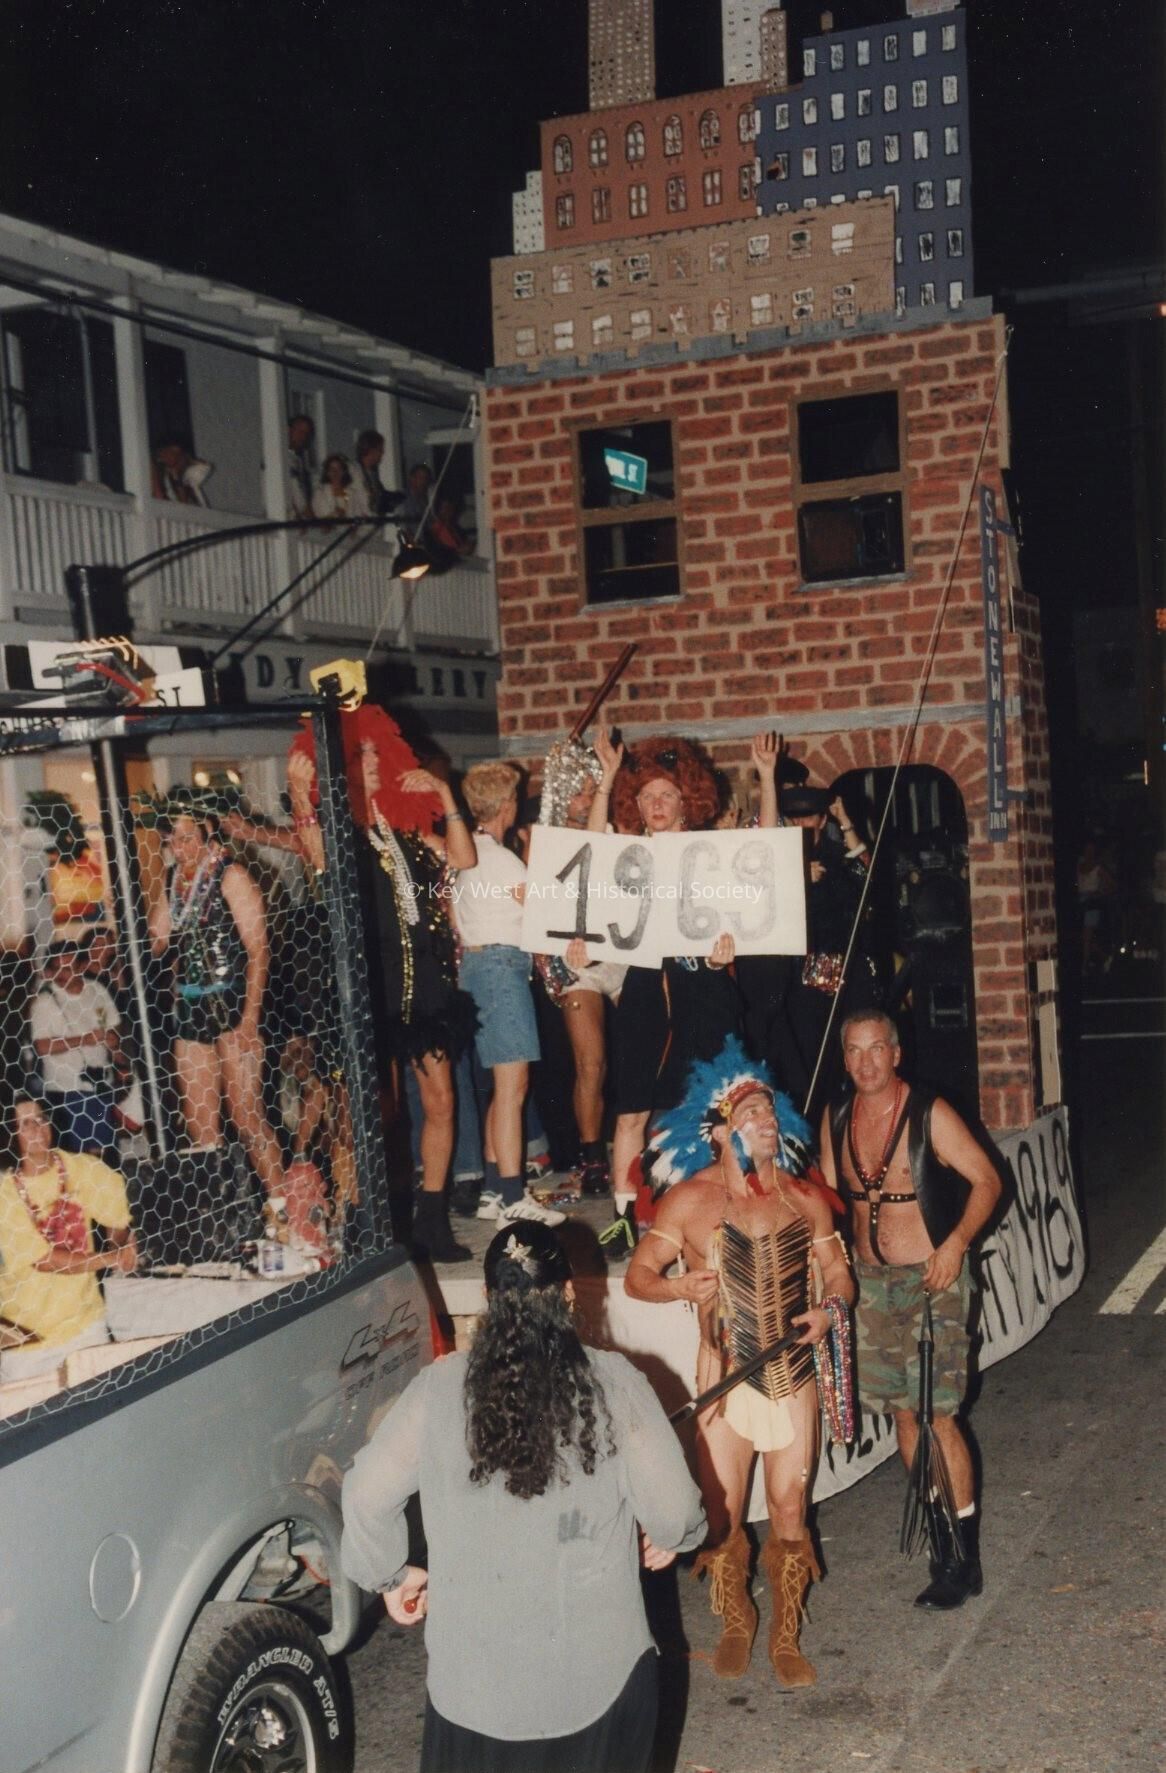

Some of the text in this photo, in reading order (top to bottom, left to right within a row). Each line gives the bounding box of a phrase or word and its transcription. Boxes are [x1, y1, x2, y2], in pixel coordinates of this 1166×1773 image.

[984, 490, 1003, 809] STONEWALL
[546, 840, 775, 951] 1969
[217, 1647, 314, 1726] WRANGLER
